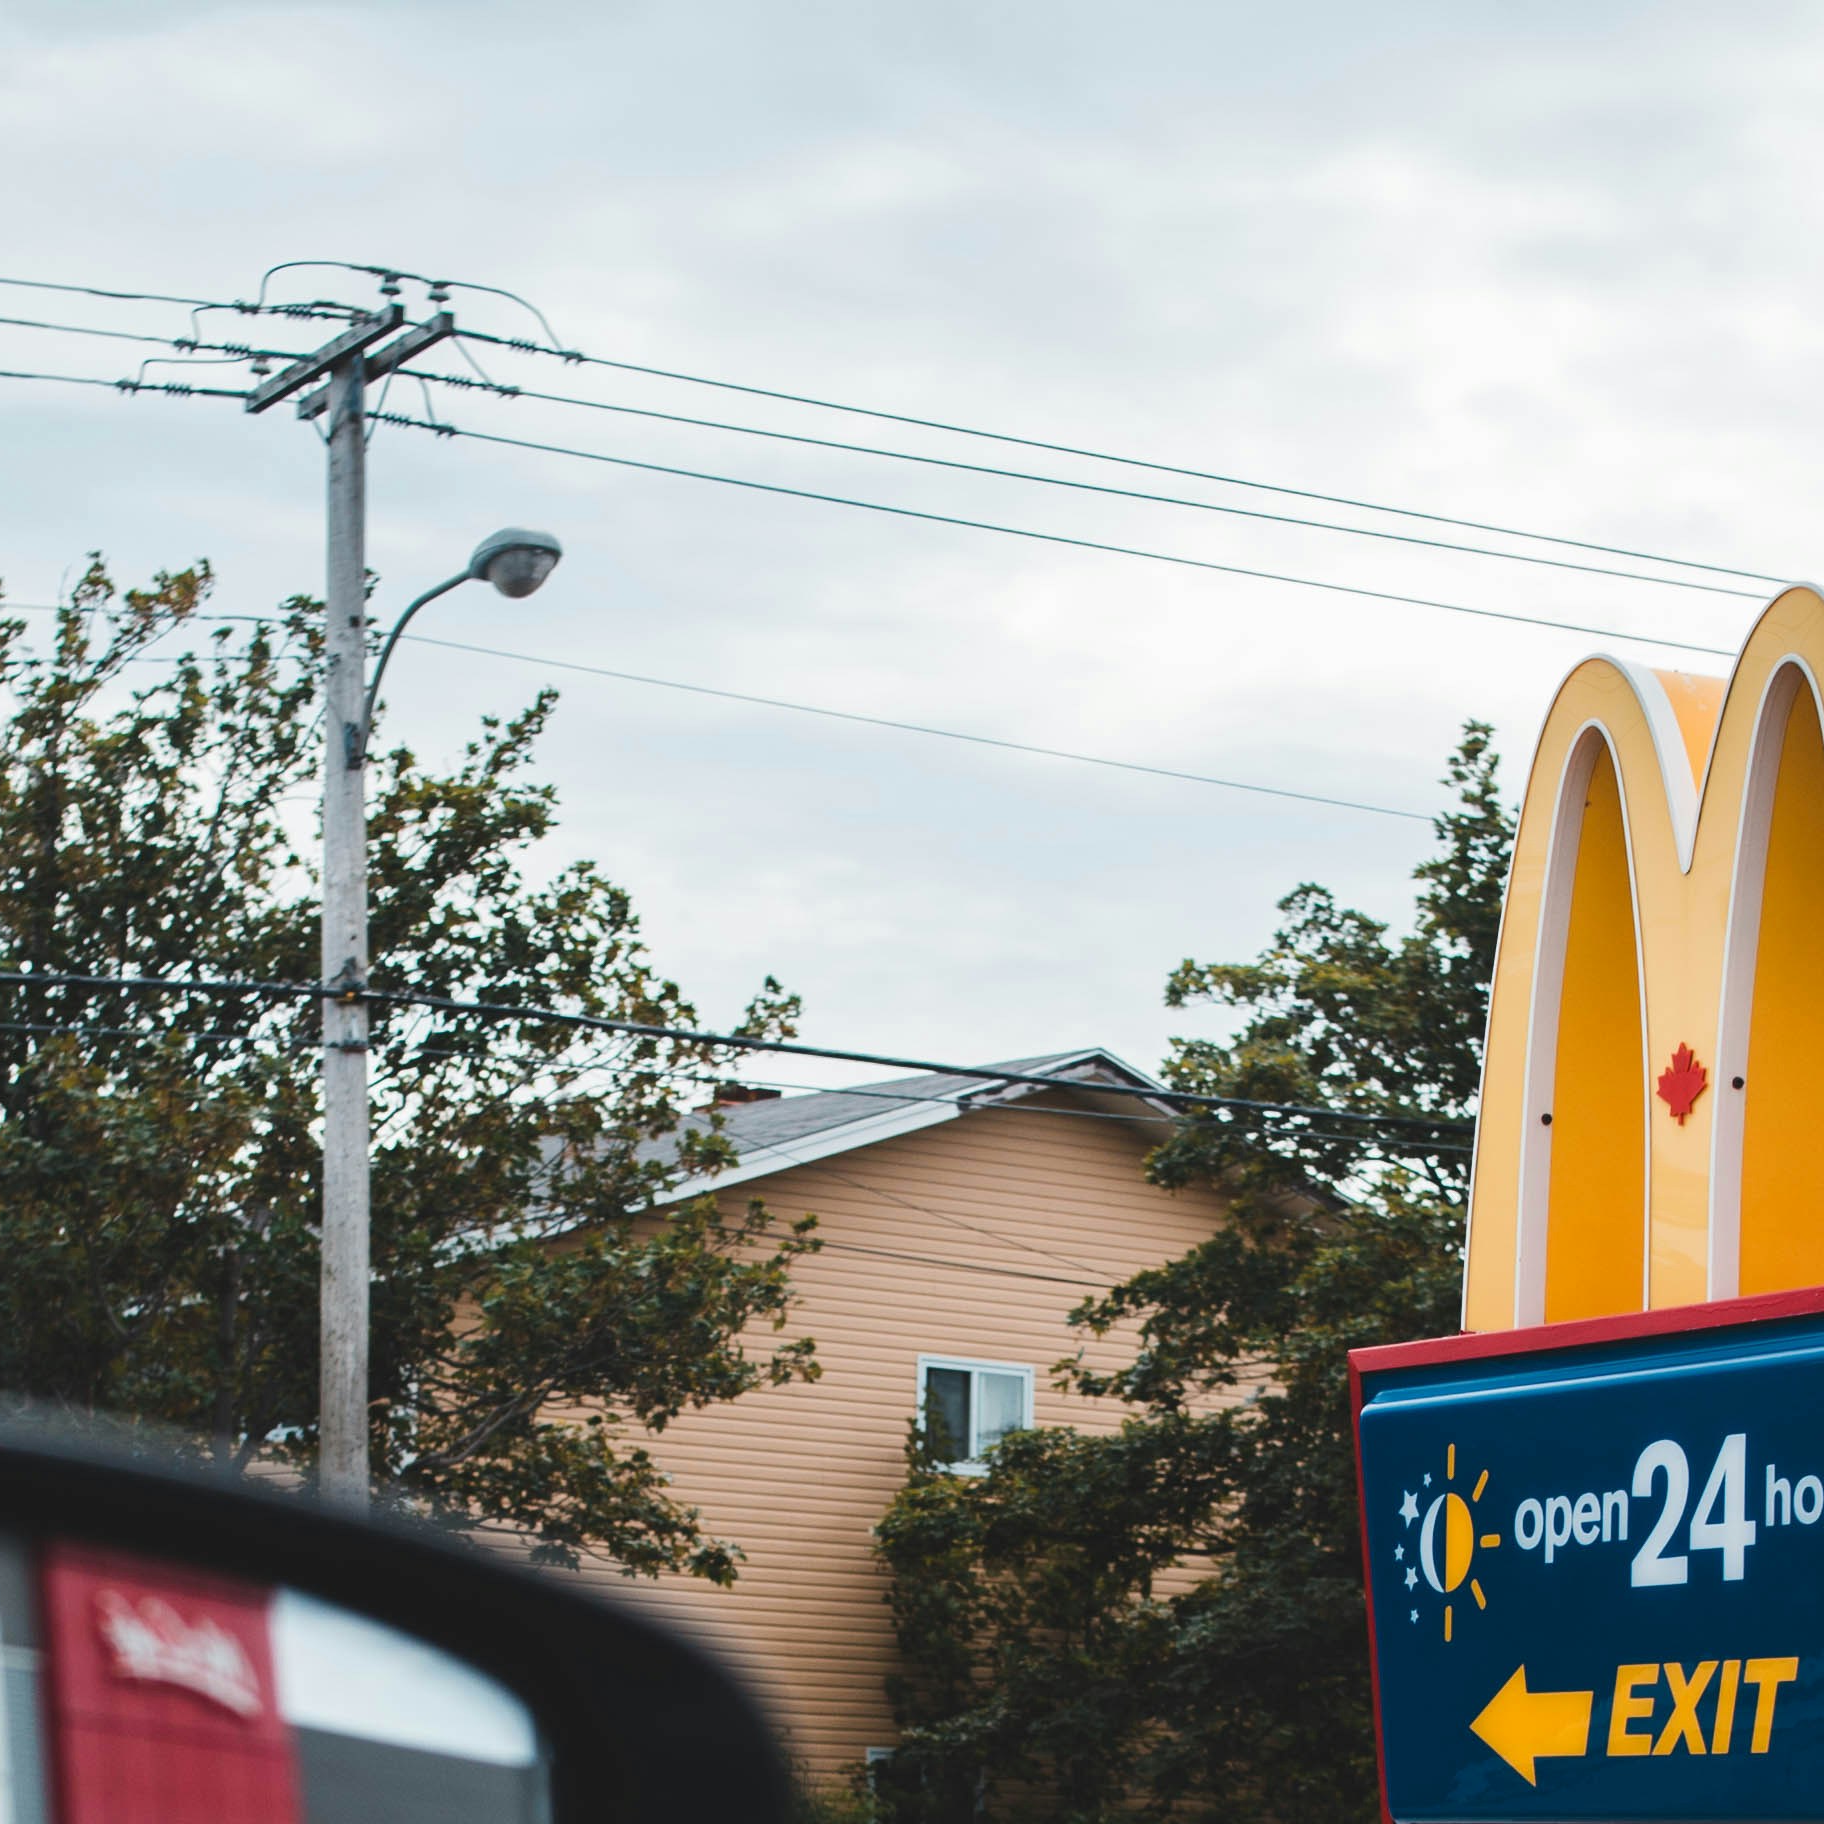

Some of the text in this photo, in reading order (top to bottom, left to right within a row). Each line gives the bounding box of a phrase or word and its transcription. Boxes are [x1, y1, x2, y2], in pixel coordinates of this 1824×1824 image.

[1514, 1489, 1629, 1564] open
[1630, 1433, 1756, 1587] 24
[1606, 1656, 1799, 1757] EXIT
